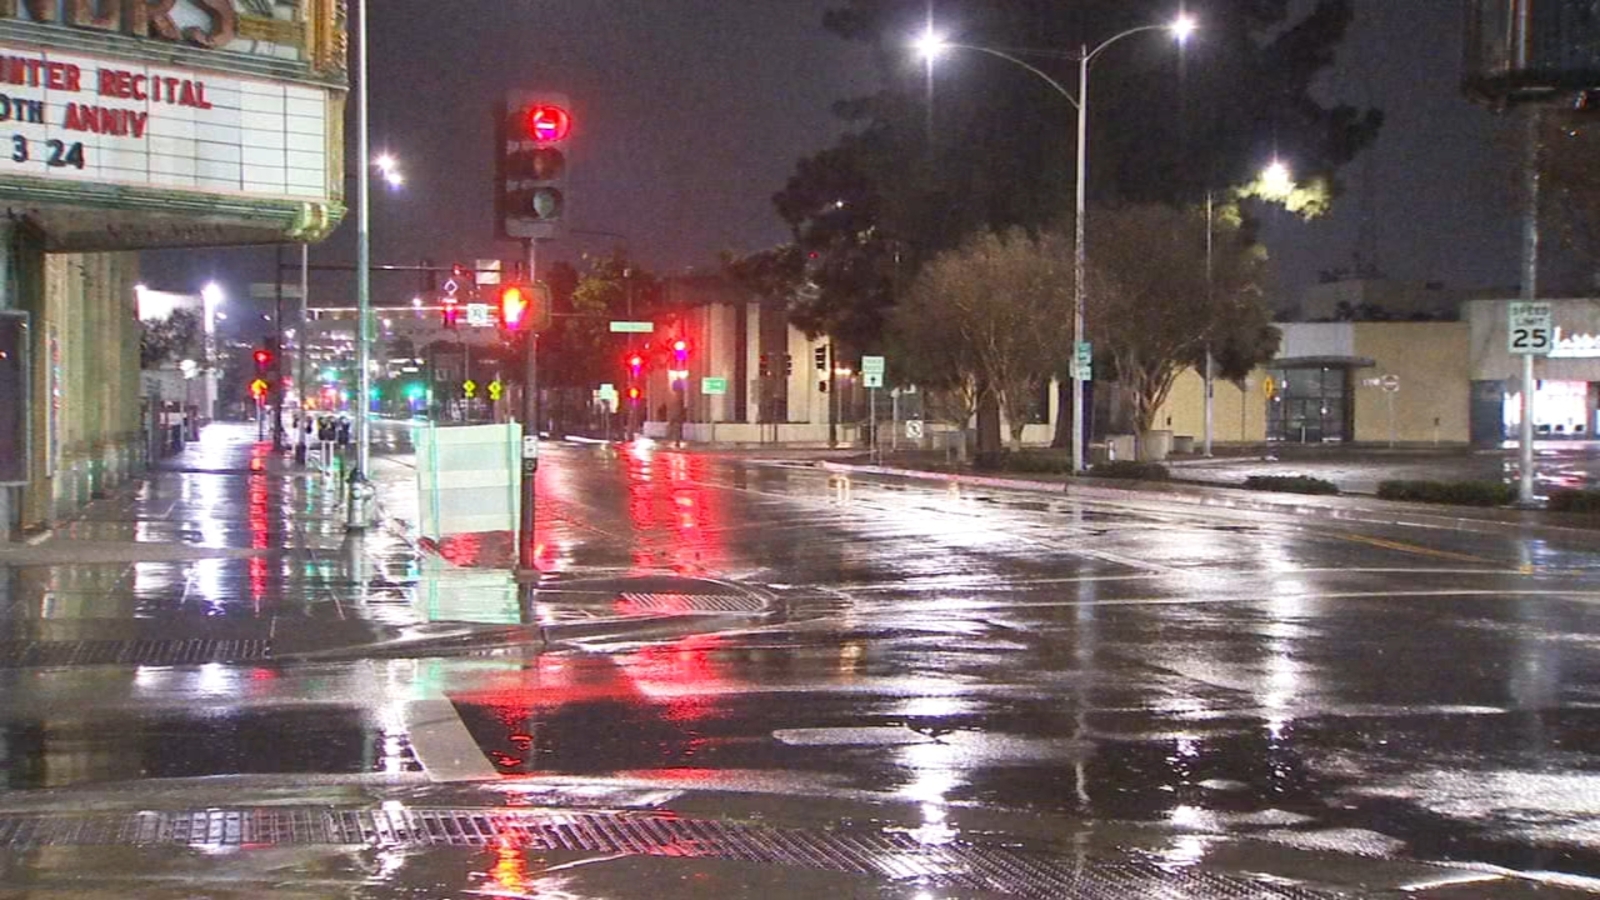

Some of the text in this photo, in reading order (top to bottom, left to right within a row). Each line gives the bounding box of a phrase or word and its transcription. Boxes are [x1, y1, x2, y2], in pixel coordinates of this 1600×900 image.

[97, 68, 212, 110] RECITAL
[64, 102, 147, 138] ANNIV
[12, 134, 85, 169] 3 24
[1513, 305, 1549, 316] SPEED
[1515, 317, 1546, 327] LIMIT
[1513, 328, 1547, 348] 25
